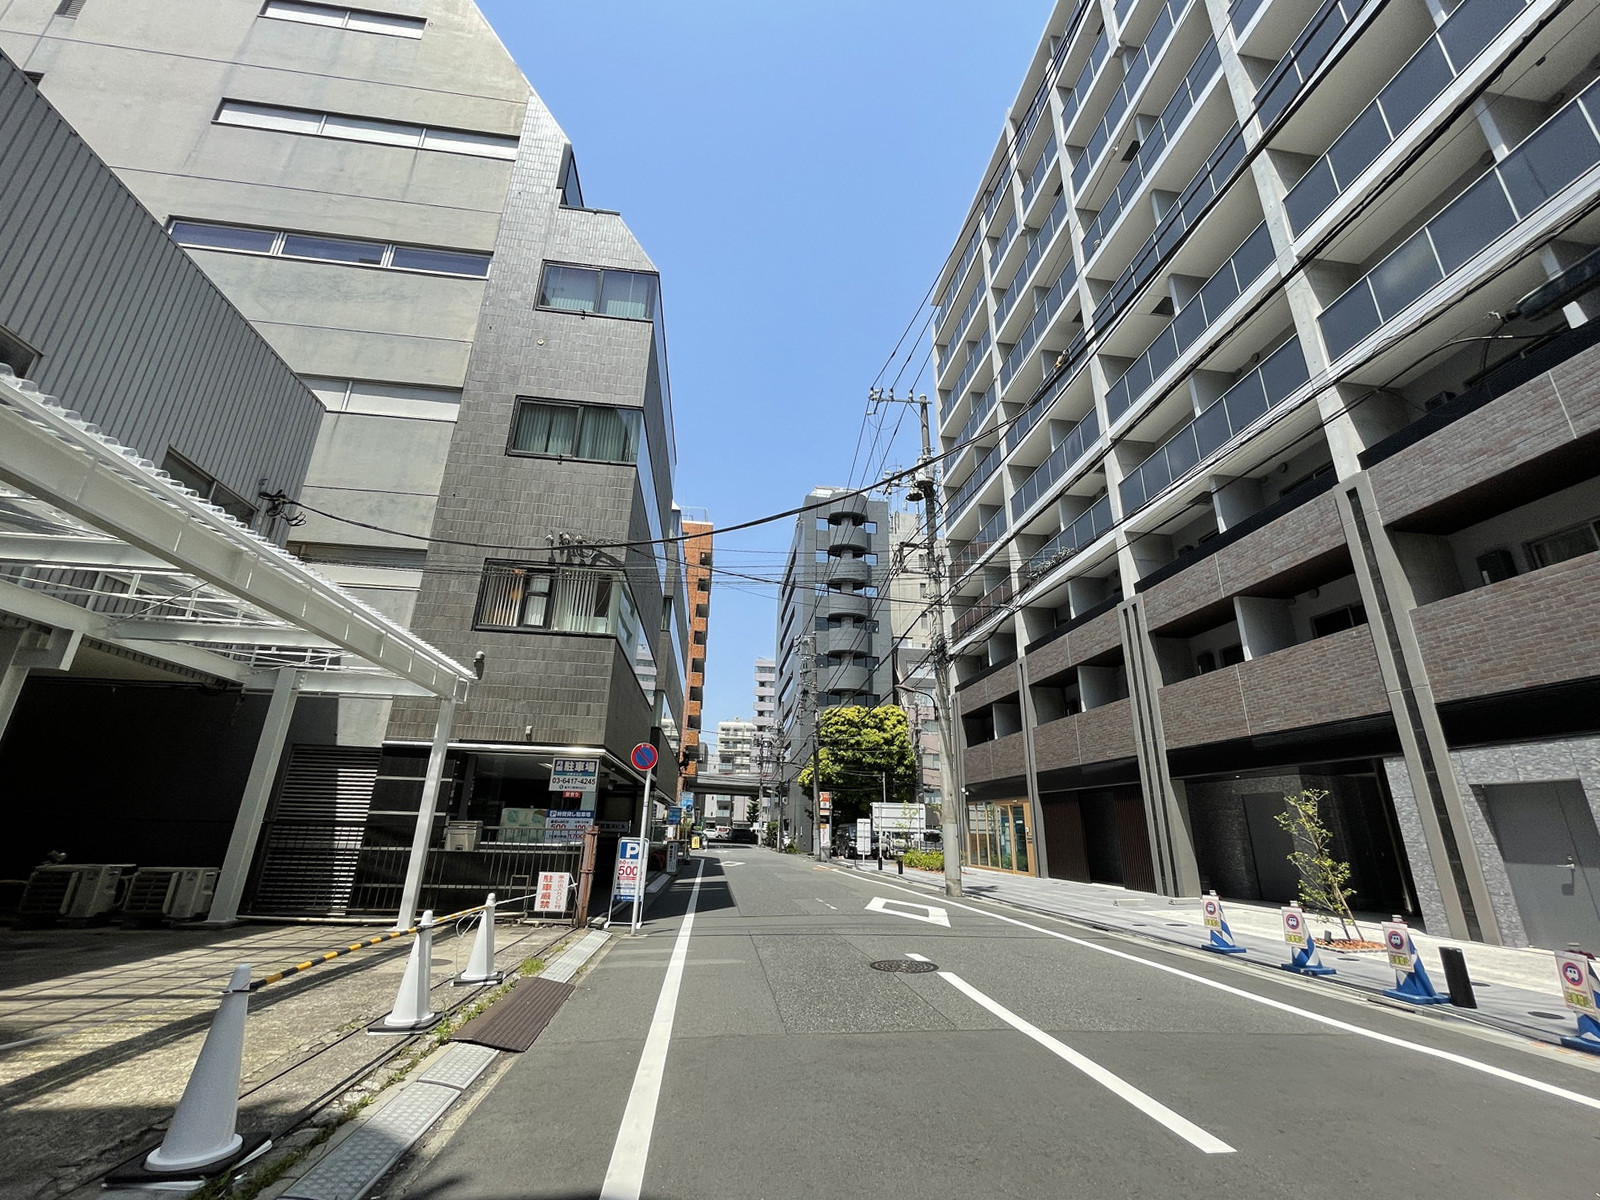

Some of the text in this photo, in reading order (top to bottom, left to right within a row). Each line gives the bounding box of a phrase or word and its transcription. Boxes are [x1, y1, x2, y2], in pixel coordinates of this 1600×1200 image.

[552, 777, 596, 785] 03-6417-4245
[625, 843, 640, 859] P
[540, 874, 553, 909] 駐車厳禁
